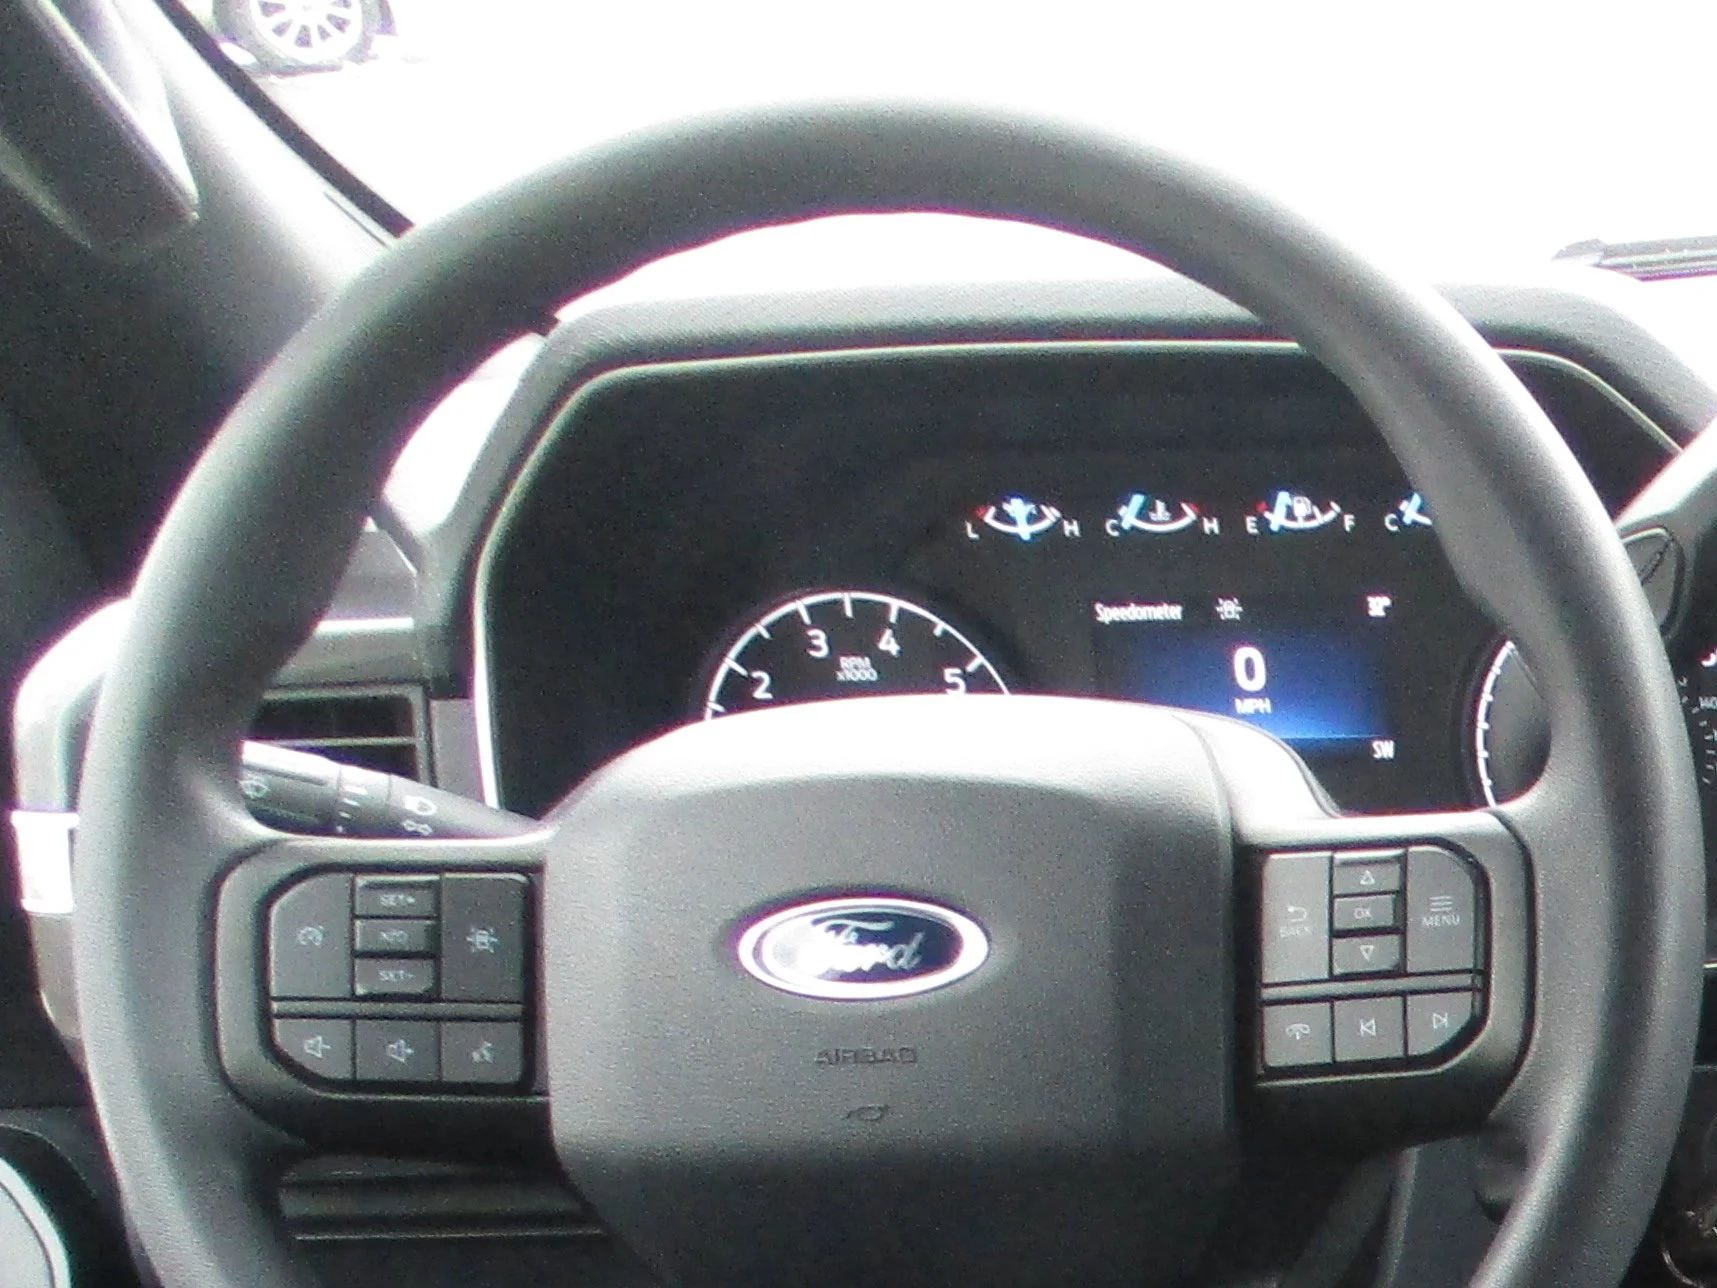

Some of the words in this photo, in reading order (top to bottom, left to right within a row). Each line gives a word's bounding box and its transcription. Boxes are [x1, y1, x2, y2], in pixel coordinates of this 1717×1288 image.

[965, 520, 980, 541] L
[1063, 518, 1082, 538] H
[1104, 519, 1122, 538] C
[1202, 516, 1221, 535] H
[1245, 515, 1259, 535] E
[1343, 513, 1357, 533] F
[1384, 513, 1400, 533] C
[1094, 601, 1184, 625] Speedometer
[806, 628, 830, 659] 3
[877, 627, 902, 658] 4
[838, 655, 873, 670] RPM
[1232, 645, 1268, 692] 0
[750, 670, 773, 700] 2
[836, 669, 879, 682] x1000
[942, 667, 967, 695] 5
[1234, 697, 1273, 715] MPH
[1371, 739, 1397, 760] SW
[1352, 907, 1373, 920] OK
[1421, 914, 1461, 928] MENU
